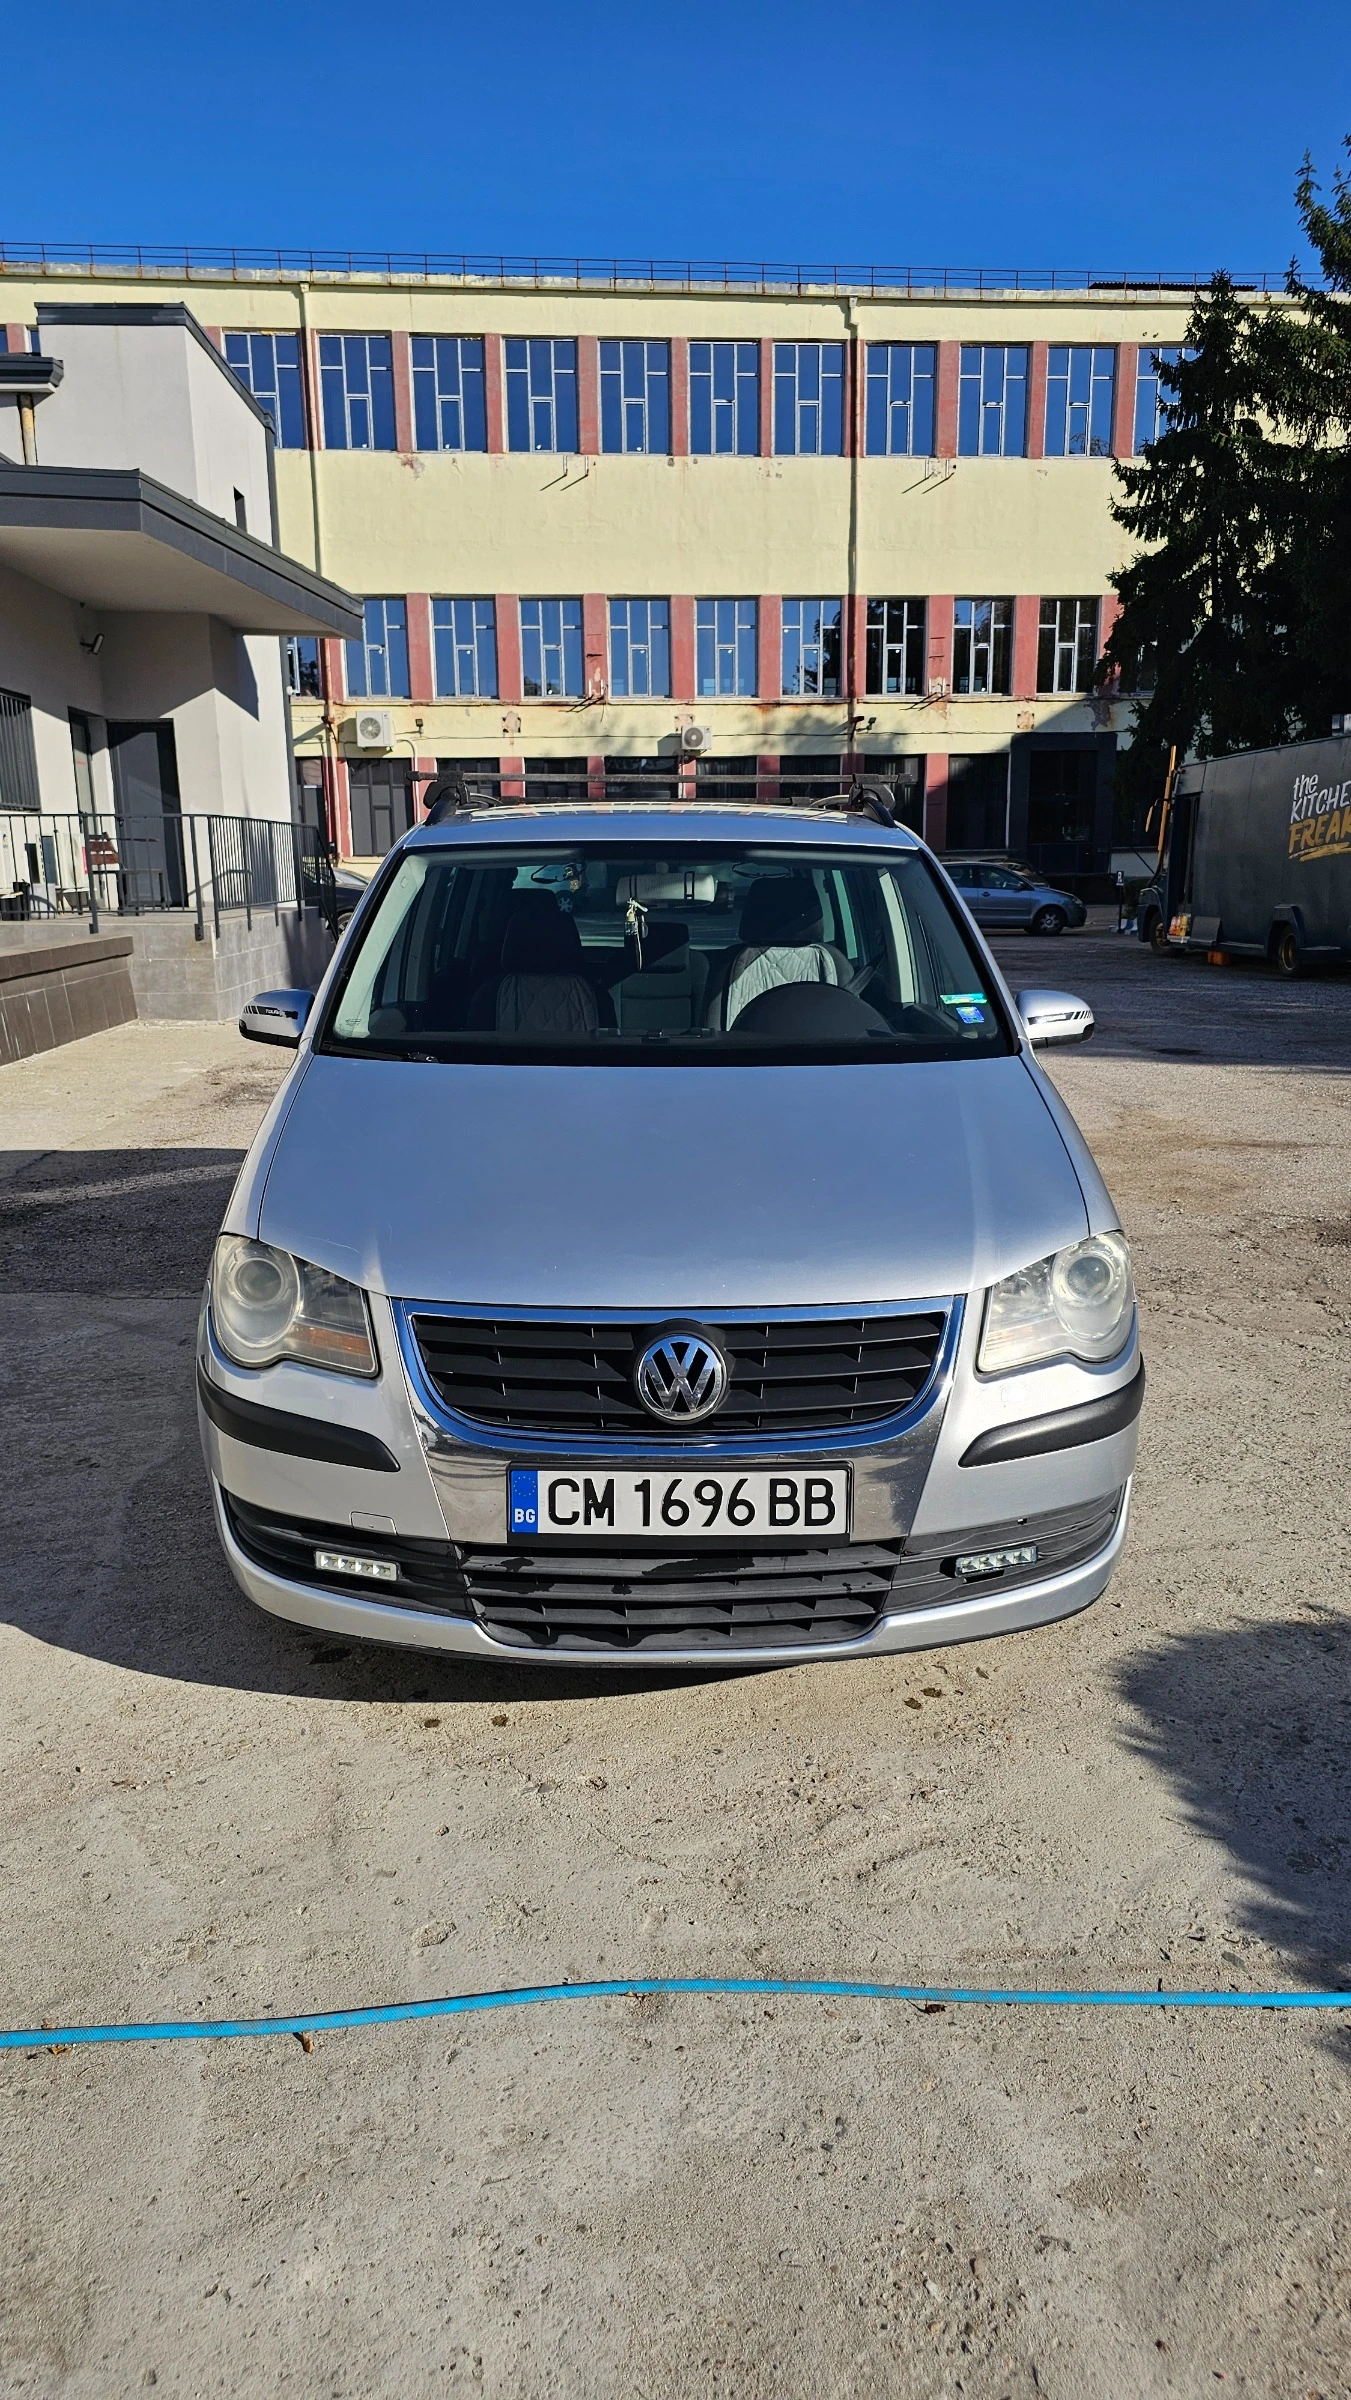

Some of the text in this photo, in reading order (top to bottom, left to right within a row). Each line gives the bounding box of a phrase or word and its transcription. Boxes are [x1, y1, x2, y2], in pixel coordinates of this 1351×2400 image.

[1290, 780, 1351, 824] KITCHE
[1293, 774, 1319, 800] the
[641, 1337, 722, 1417] VW
[514, 1508, 536, 1523] BG
[548, 1478, 835, 1527] CM 1696 BB
